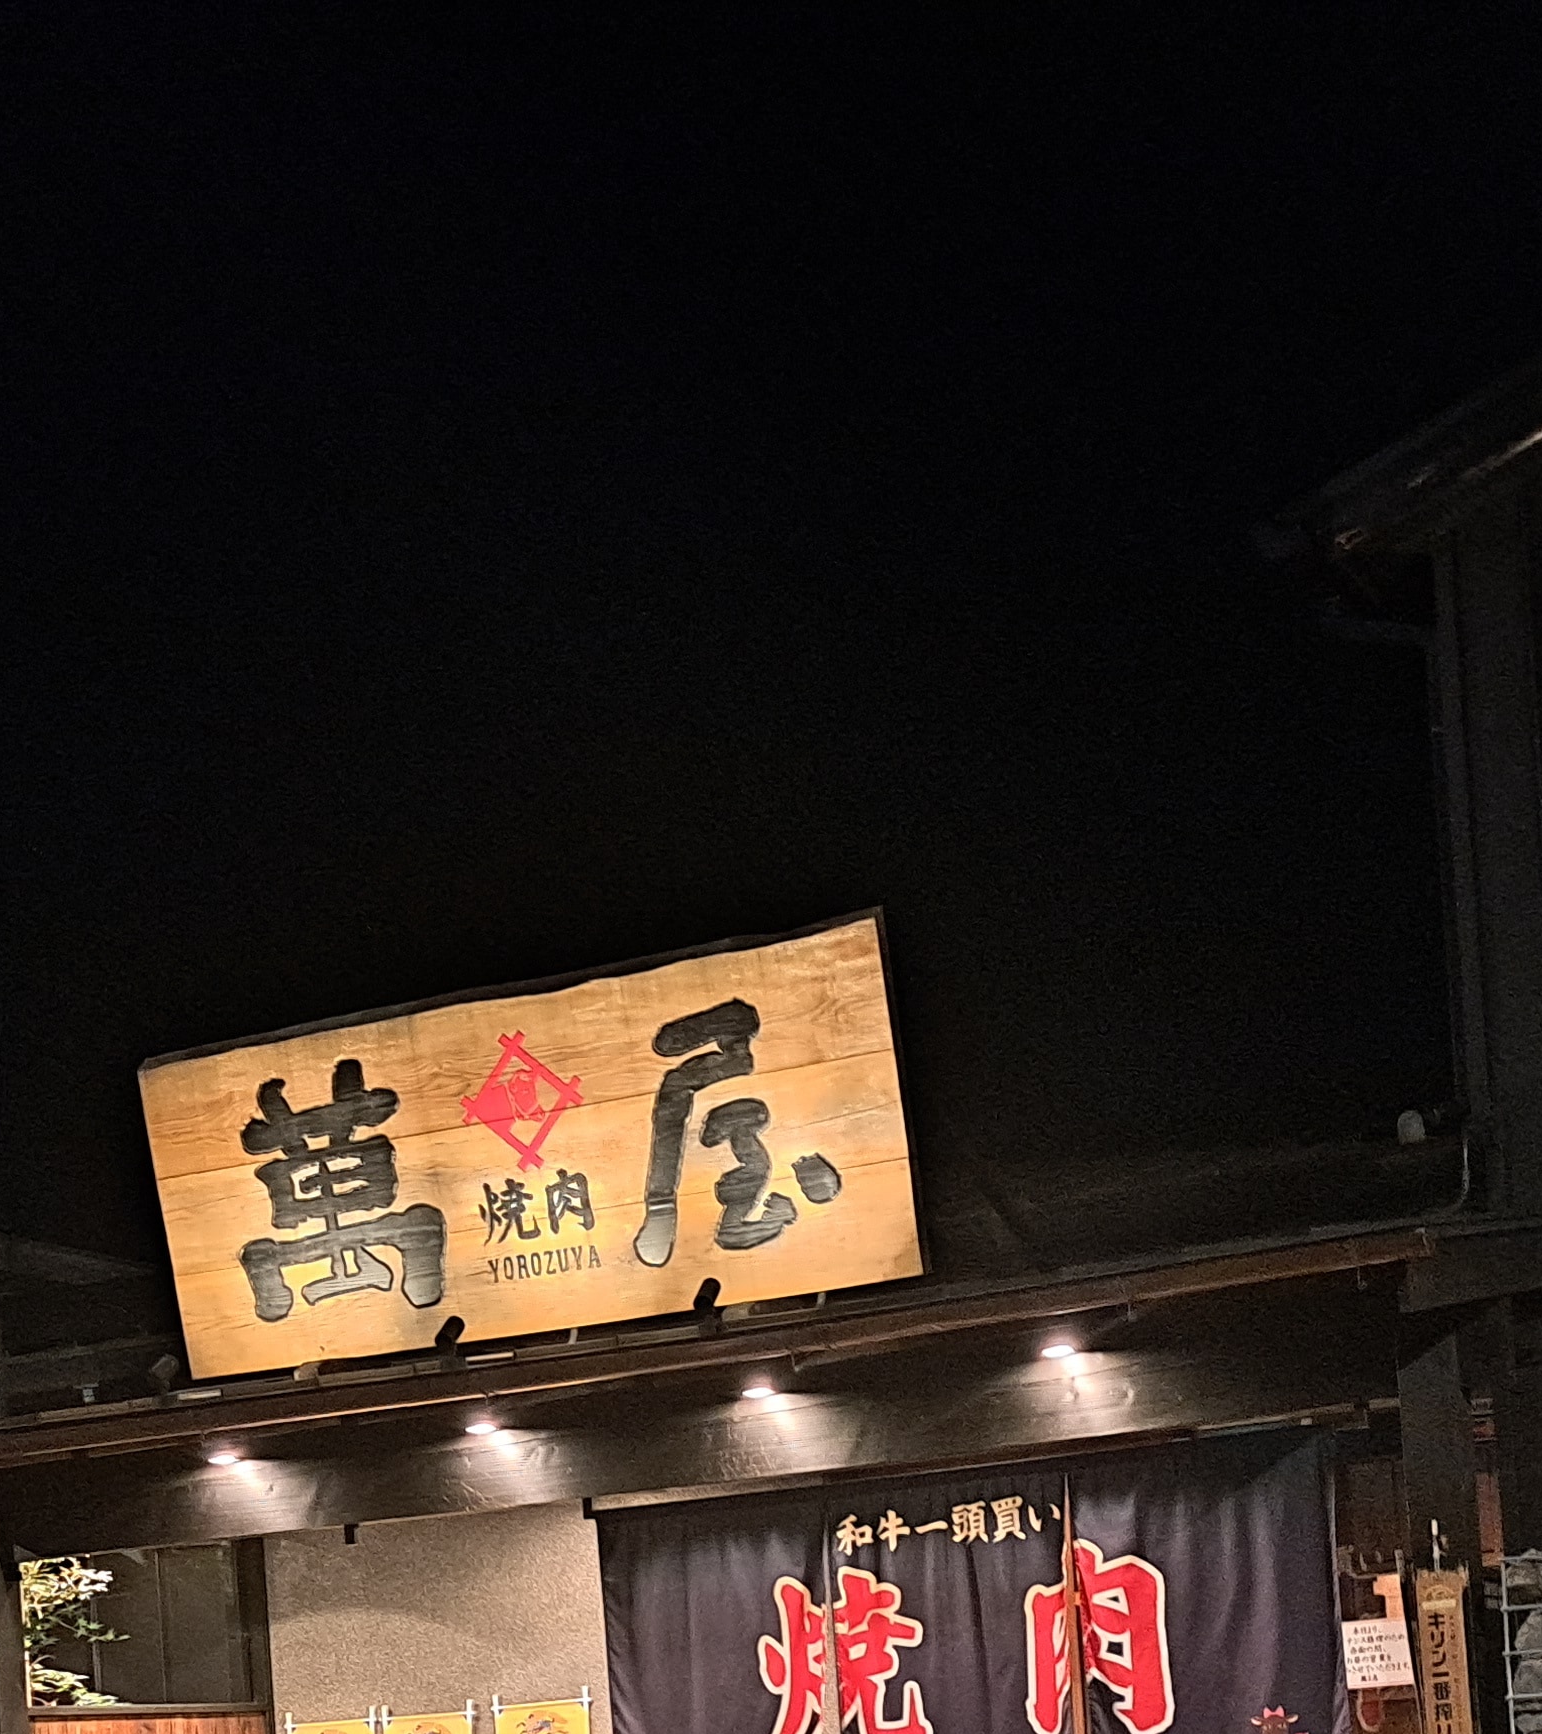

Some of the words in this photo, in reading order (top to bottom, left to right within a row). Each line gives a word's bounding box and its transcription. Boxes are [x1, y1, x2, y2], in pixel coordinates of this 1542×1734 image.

[478, 1168, 595, 1247] 焼肉
[487, 1244, 602, 1284] YOROZUYA
[835, 1495, 1061, 1557] 和牛一頭買い
